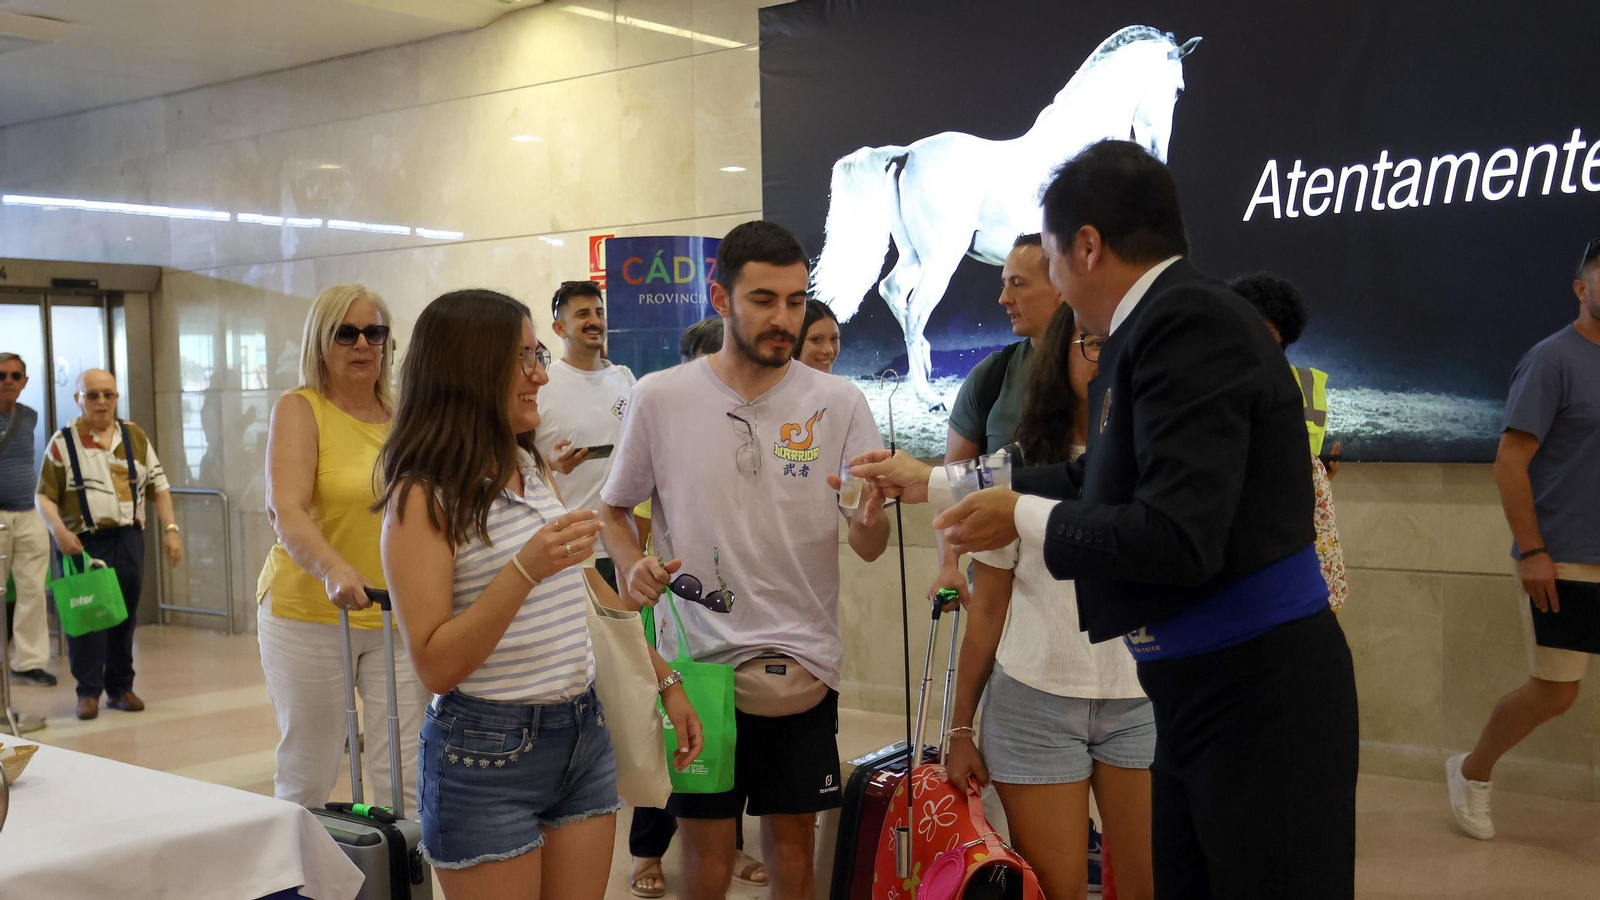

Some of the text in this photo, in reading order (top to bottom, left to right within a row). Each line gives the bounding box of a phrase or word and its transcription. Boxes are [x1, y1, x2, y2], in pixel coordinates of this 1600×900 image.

[1242, 127, 1600, 223] Atentamente
[638, 293, 709, 304] PROVINCIA
[773, 442, 820, 462] WARRIOR
[783, 463, 810, 478] 武者
